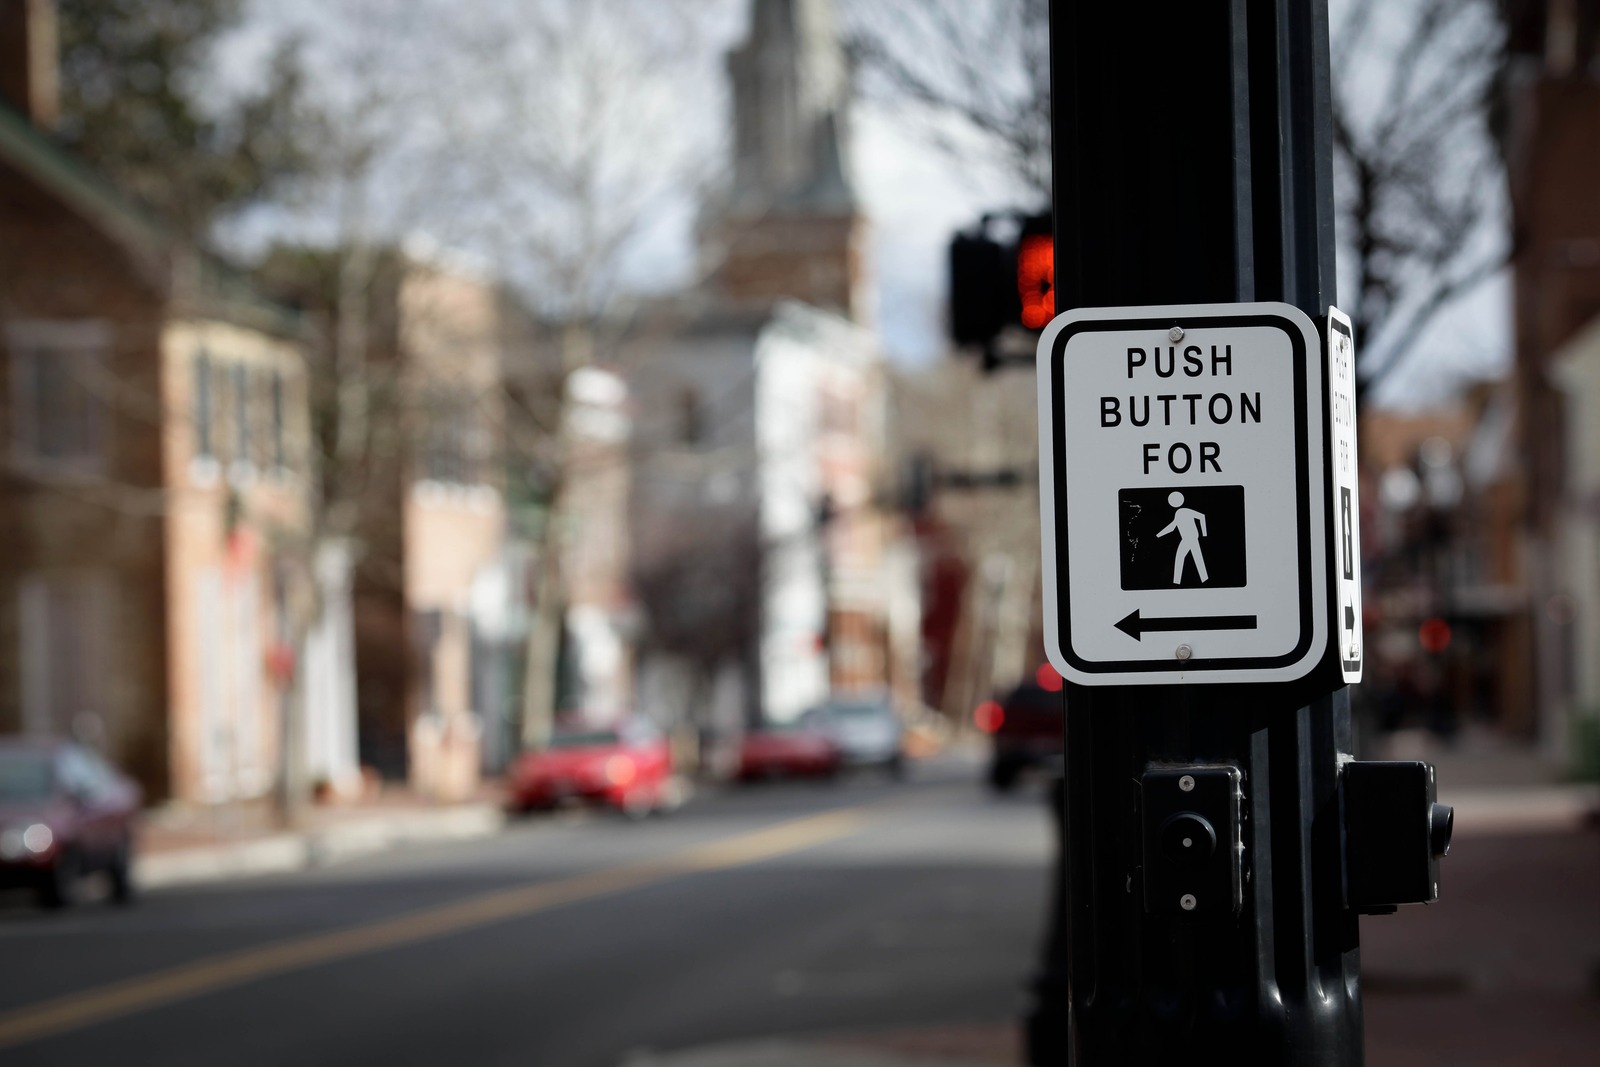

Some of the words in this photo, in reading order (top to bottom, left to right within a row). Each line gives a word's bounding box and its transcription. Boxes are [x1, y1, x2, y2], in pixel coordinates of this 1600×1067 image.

[1127, 345, 1232, 378] PUSH
[1100, 391, 1262, 428] BUTTON
[1142, 441, 1223, 475] FOR
